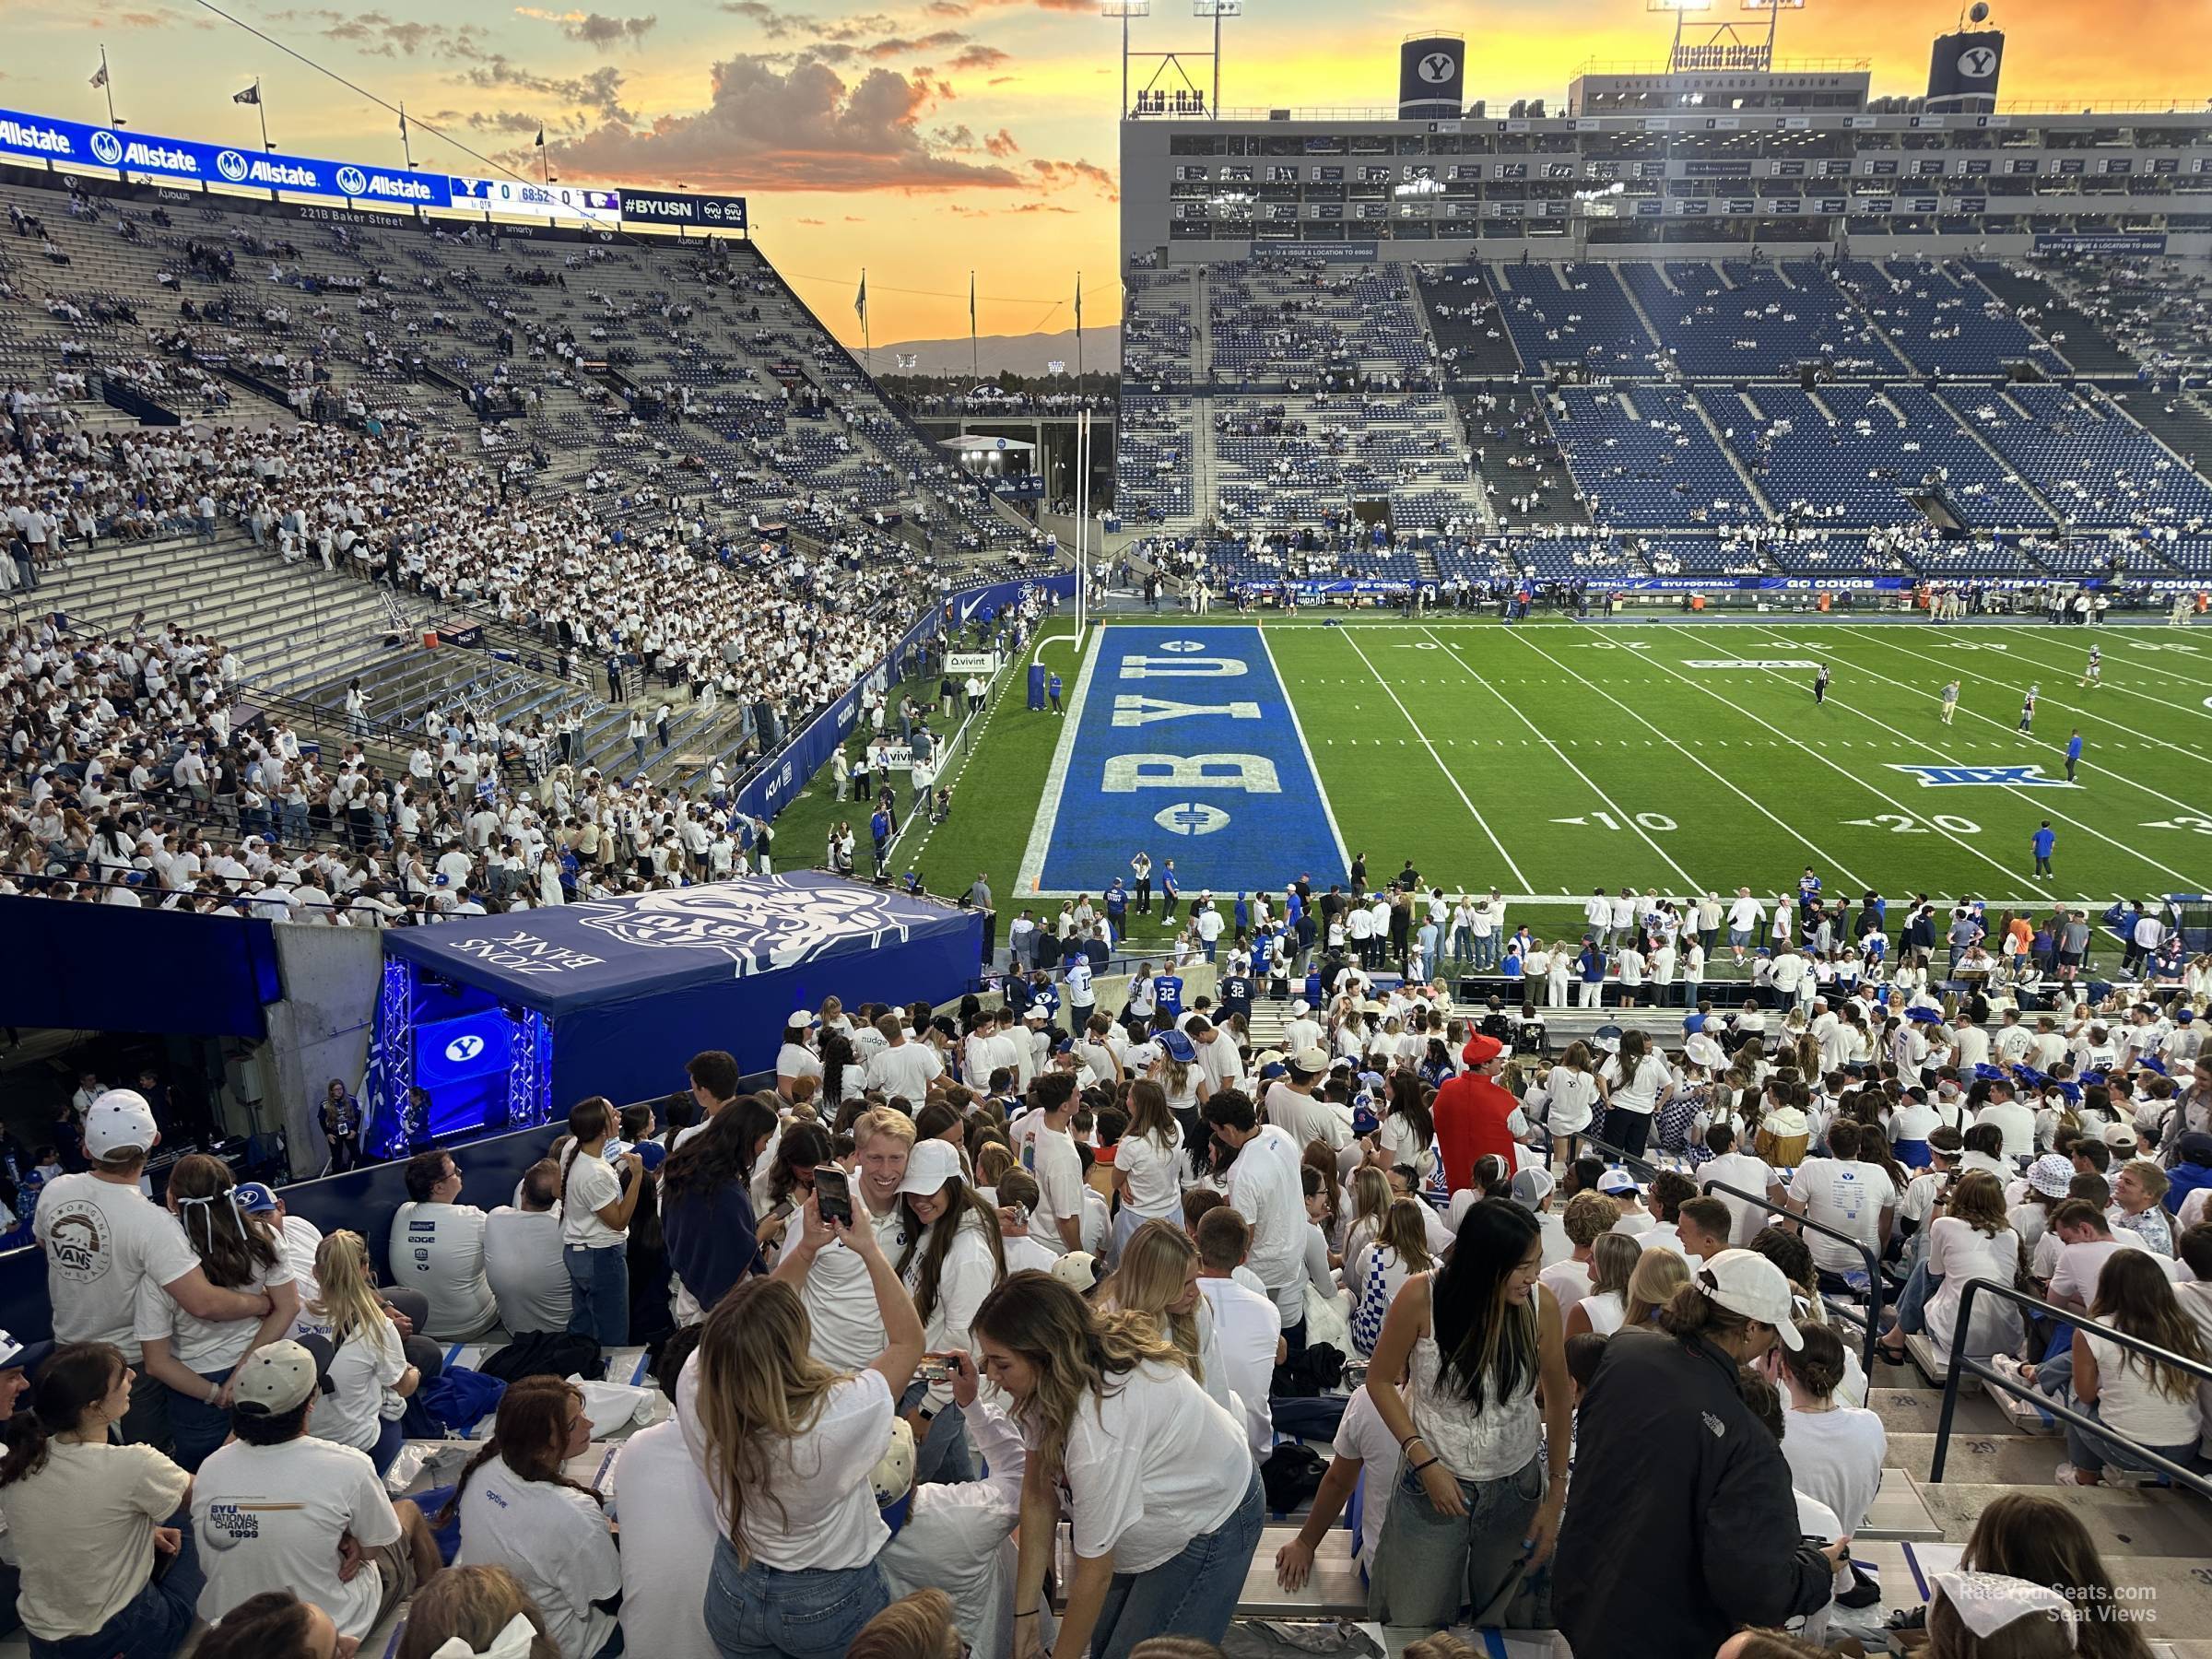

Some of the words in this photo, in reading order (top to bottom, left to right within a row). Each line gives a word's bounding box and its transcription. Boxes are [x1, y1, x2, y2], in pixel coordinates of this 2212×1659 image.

[1425, 56, 1450, 80] Y
[1966, 50, 1992, 74] Y
[1616, 81, 1671, 89] LAVELL
[1684, 79, 1756, 88] EDWARDS
[1769, 78, 1841, 87] STADIUM
[501, 184, 510, 199] 0
[625, 198, 692, 217] #BYUSN
[300, 206, 329, 219] 221B
[332, 210, 365, 223] Baker
[369, 215, 403, 227] Street
[506, 225, 533, 236] smarty
[1786, 580, 1810, 588] GO
[1814, 580, 1875, 589] COUGS
[960, 657, 984, 665] vivint
[1101, 655, 1282, 793] BYU
[1592, 812, 1678, 830] 10
[1875, 815, 1982, 833] 20
[449, 938, 563, 975] ZIONS
[491, 930, 607, 970] BANK
[1159, 987, 1175, 1001] 32
[1231, 985, 1244, 998] 32
[453, 1038, 477, 1059] Y
[862, 1037, 888, 1046] nudge
[52, 1241, 93, 1270] VANS
[1890, 1395, 1918, 1407] 28
[1966, 1441, 1995, 1453] 29
[486, 1488, 507, 1509] aptive
[211, 1504, 238, 1513] BYU
[210, 1514, 258, 1523] NATIONAL
[215, 1521, 258, 1530] CHAMPS
